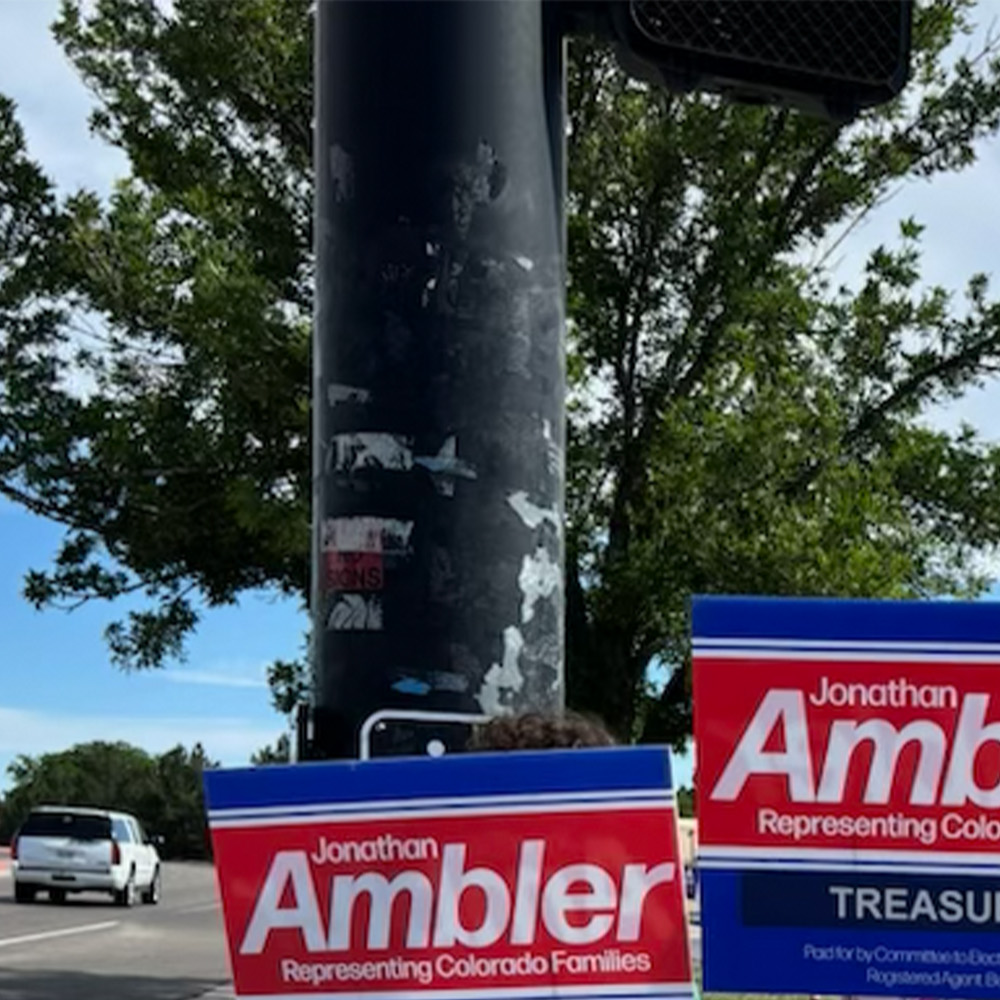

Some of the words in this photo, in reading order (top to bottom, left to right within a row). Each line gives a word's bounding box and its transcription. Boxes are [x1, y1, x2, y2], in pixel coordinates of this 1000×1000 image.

[809, 677, 959, 709] Jonathan
[757, 808, 937, 844] Representing
[311, 834, 438, 866] Jonathan
[239, 838, 676, 955] Ambler
[281, 957, 433, 986] Representing
[435, 954, 549, 979] Colorado
[551, 950, 651, 975] Families
[834, 946, 854, 962] for
[856, 946, 872, 965] by
[866, 966, 941, 987] Registered
